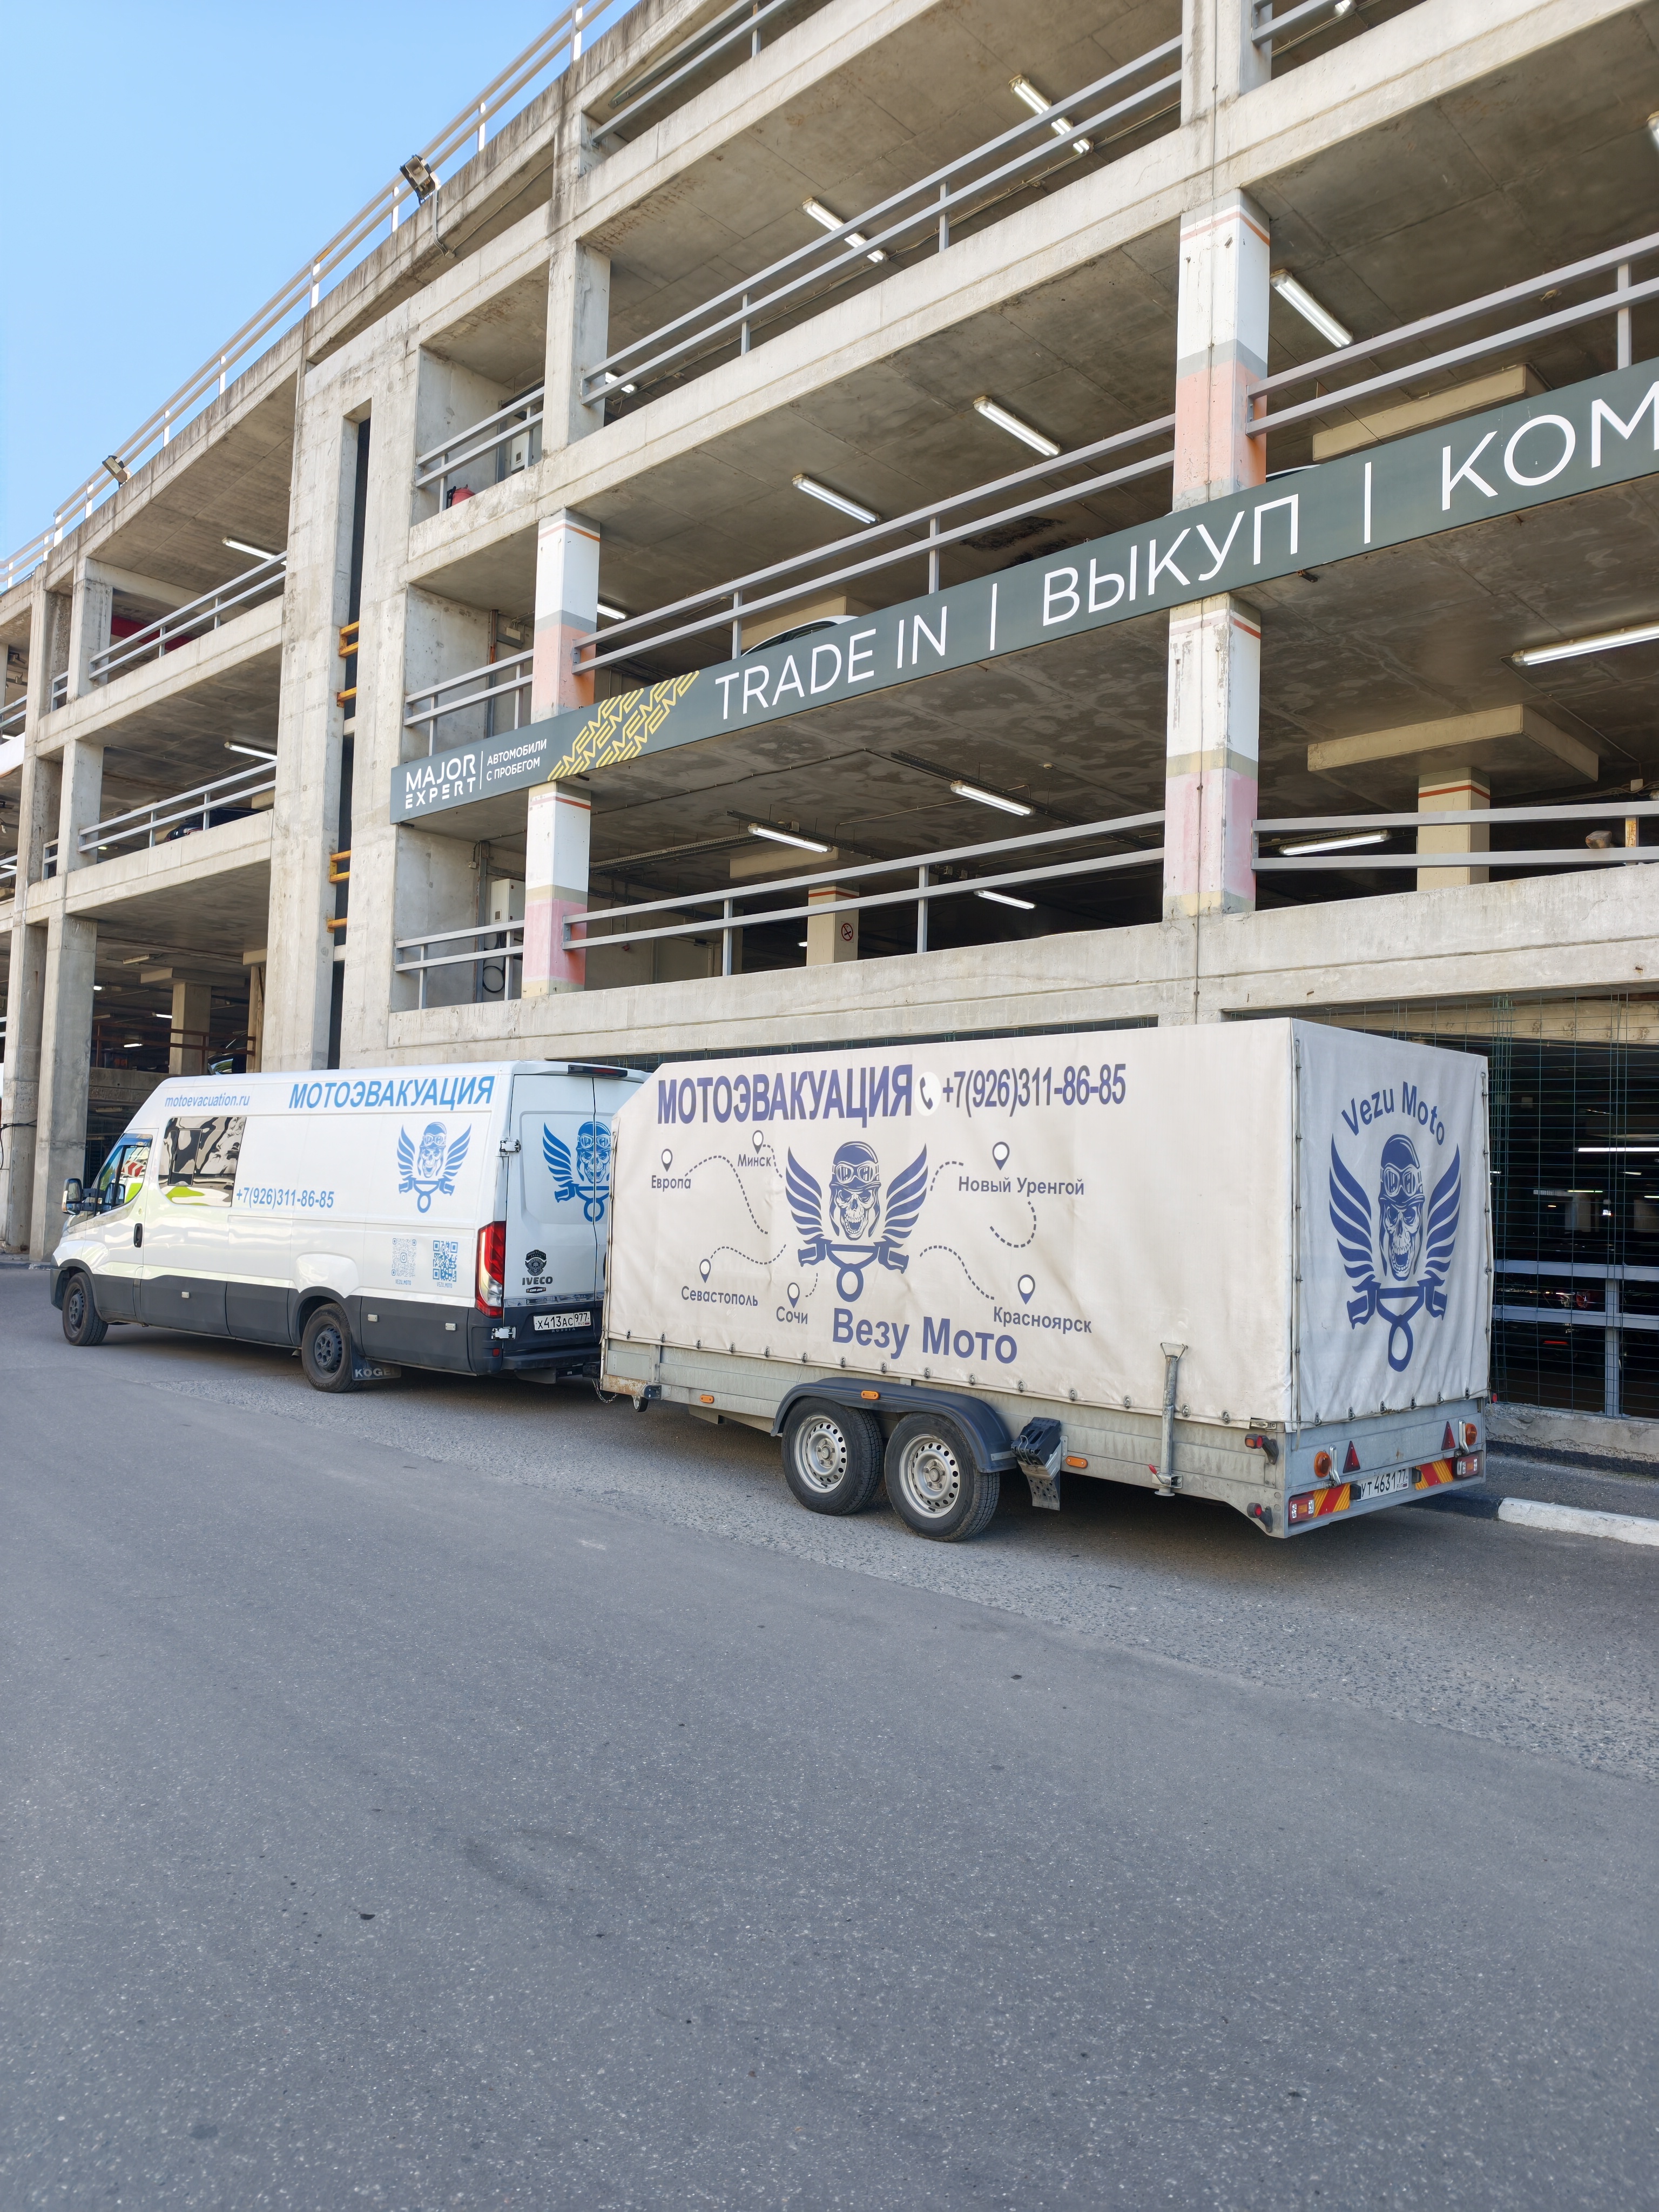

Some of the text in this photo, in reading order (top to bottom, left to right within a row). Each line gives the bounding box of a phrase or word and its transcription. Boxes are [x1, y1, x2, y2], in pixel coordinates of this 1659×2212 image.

[714, 380, 1659, 720] TRADE IN ВЫКУП КОМ
[487, 738, 547, 766] АВТОМОБИЛИ
[405, 753, 476, 792] MAJOR
[486, 757, 541, 781] С ПРОБЕГОМ
[405, 775, 477, 810] EXPERT
[164, 1092, 251, 1108] motoevacuation.ru
[289, 1075, 495, 1110] МОТОЭВАКУАЦИЯ
[657, 1063, 1127, 1129] МОТОЭВАКУАЦИЯ +7(926)311-86-85
[1341, 1081, 1445, 1146] Vezu Moto
[737, 1154, 772, 1168] Минск
[650, 1174, 692, 1191] Европа
[959, 1176, 1085, 1198] Новый Уренгой
[236, 1187, 335, 1210] +7(926)311-86-85
[522, 1276, 554, 1286] IVECO
[680, 1285, 758, 1307] Севастополь
[574, 1312, 588, 1323] 977
[775, 1306, 808, 1325] Сочи
[993, 1306, 1092, 1334] Красноярск
[832, 1308, 1018, 1365] Везу Мото
